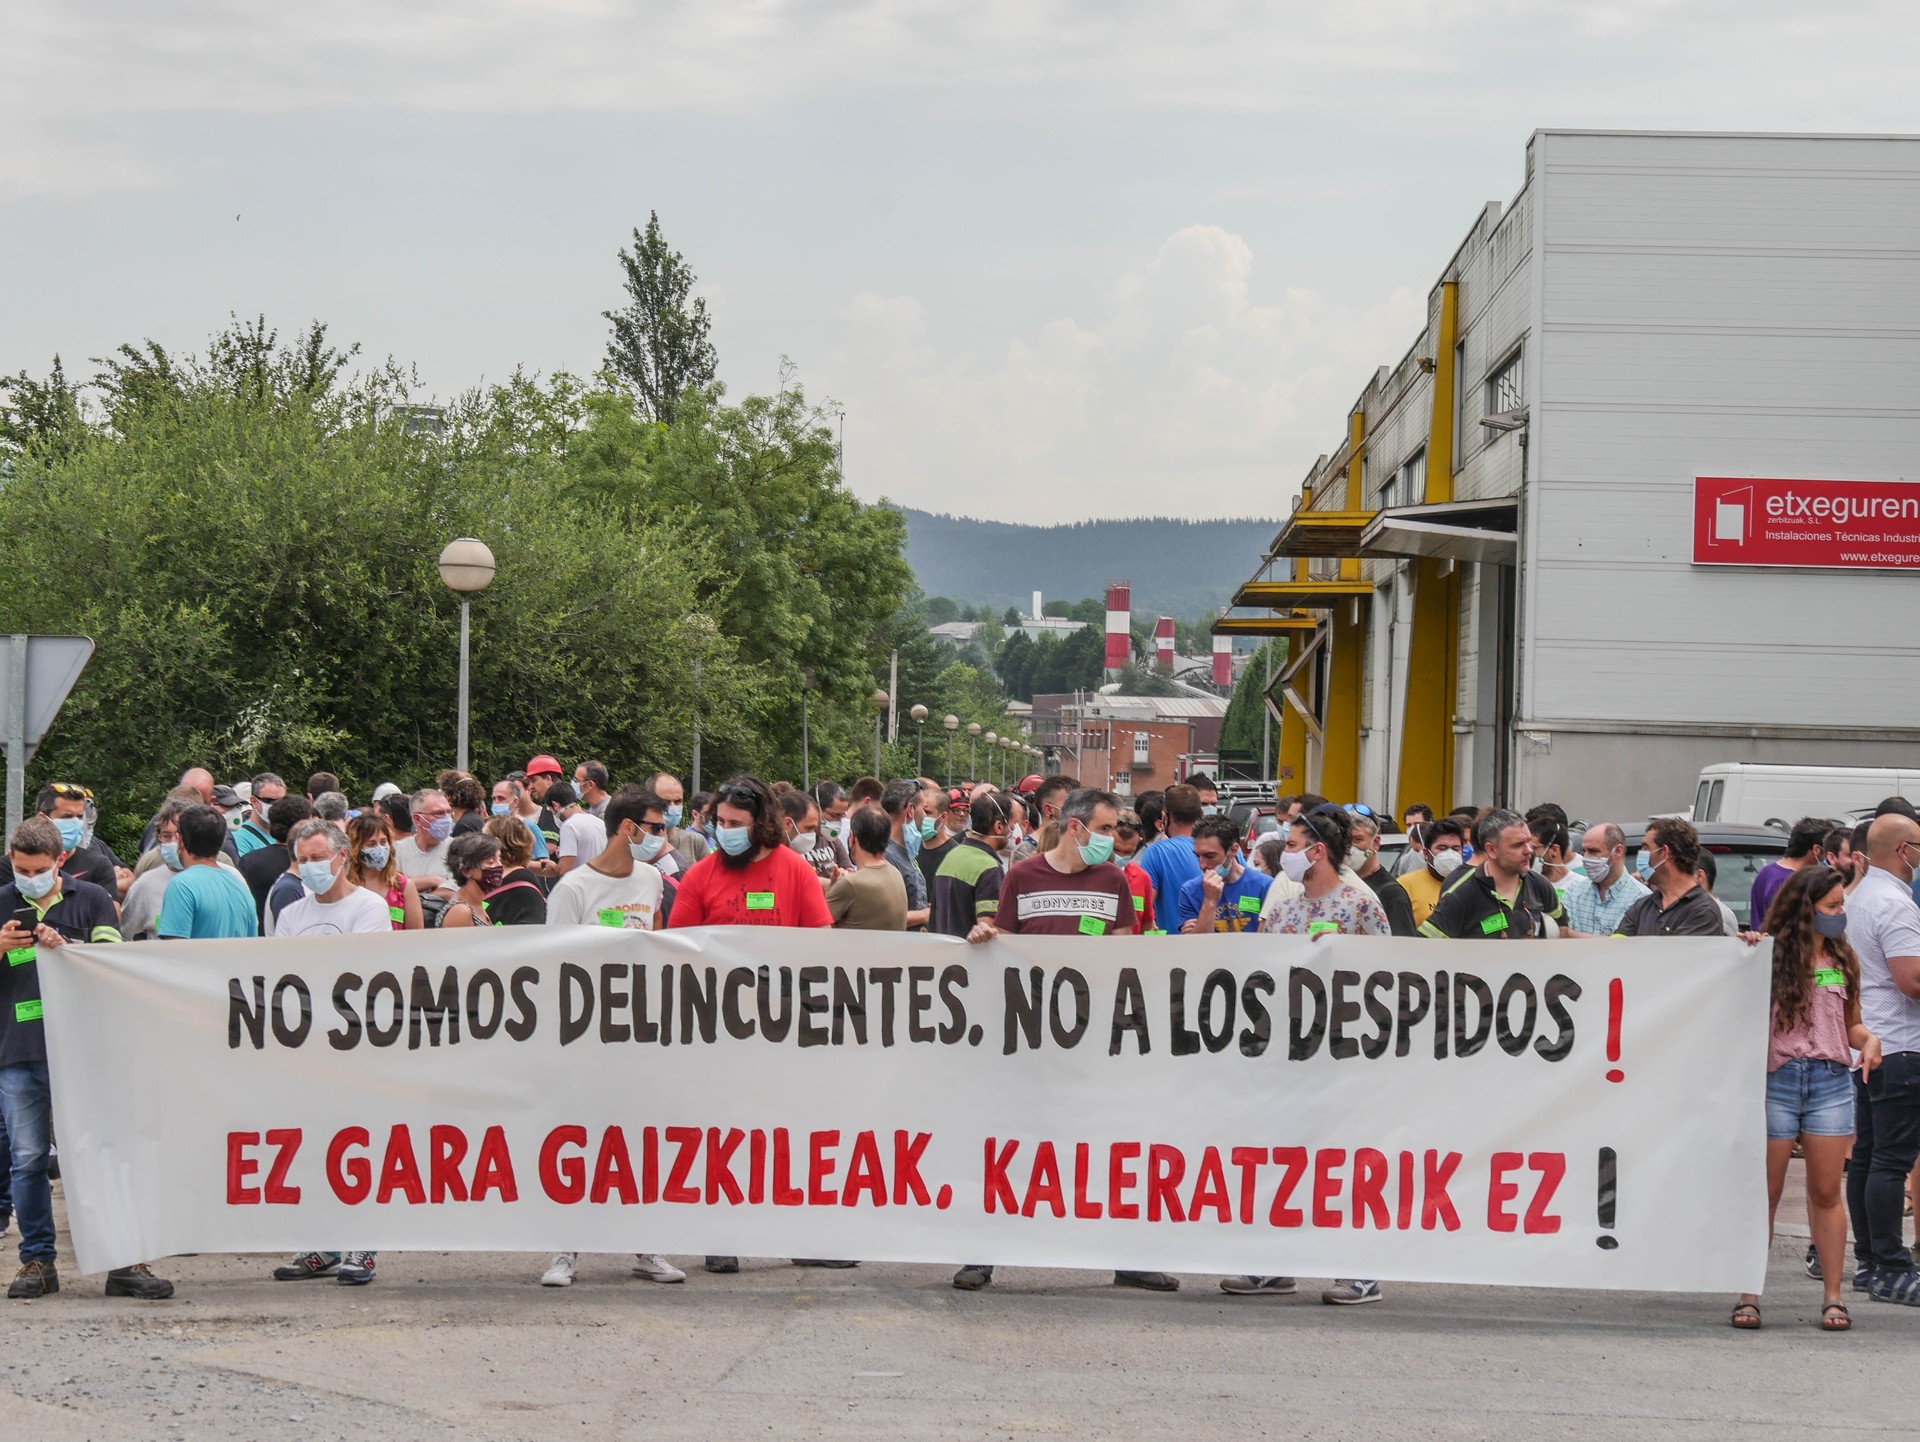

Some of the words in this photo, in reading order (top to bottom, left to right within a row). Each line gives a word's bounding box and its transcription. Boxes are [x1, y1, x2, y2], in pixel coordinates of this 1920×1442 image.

[1766, 490, 1919, 524] etxeguren
[1765, 530, 1832, 541] Instalaciones
[1834, 531, 1880, 542] Técnicas
[1032, 897, 1105, 911] CONVERSE
[228, 973, 313, 1050] NO
[327, 965, 540, 1051] SOMOS
[558, 961, 984, 1048] DELINCUENTES.
[1002, 965, 1091, 1055] NO
[1108, 967, 1152, 1056] A
[1169, 967, 1276, 1058] LOS
[226, 1128, 303, 1205] EZ
[325, 1123, 519, 1205] GARA
[983, 1136, 1463, 1232] KALERATZERIK
[1487, 1151, 1567, 1235] EZ
